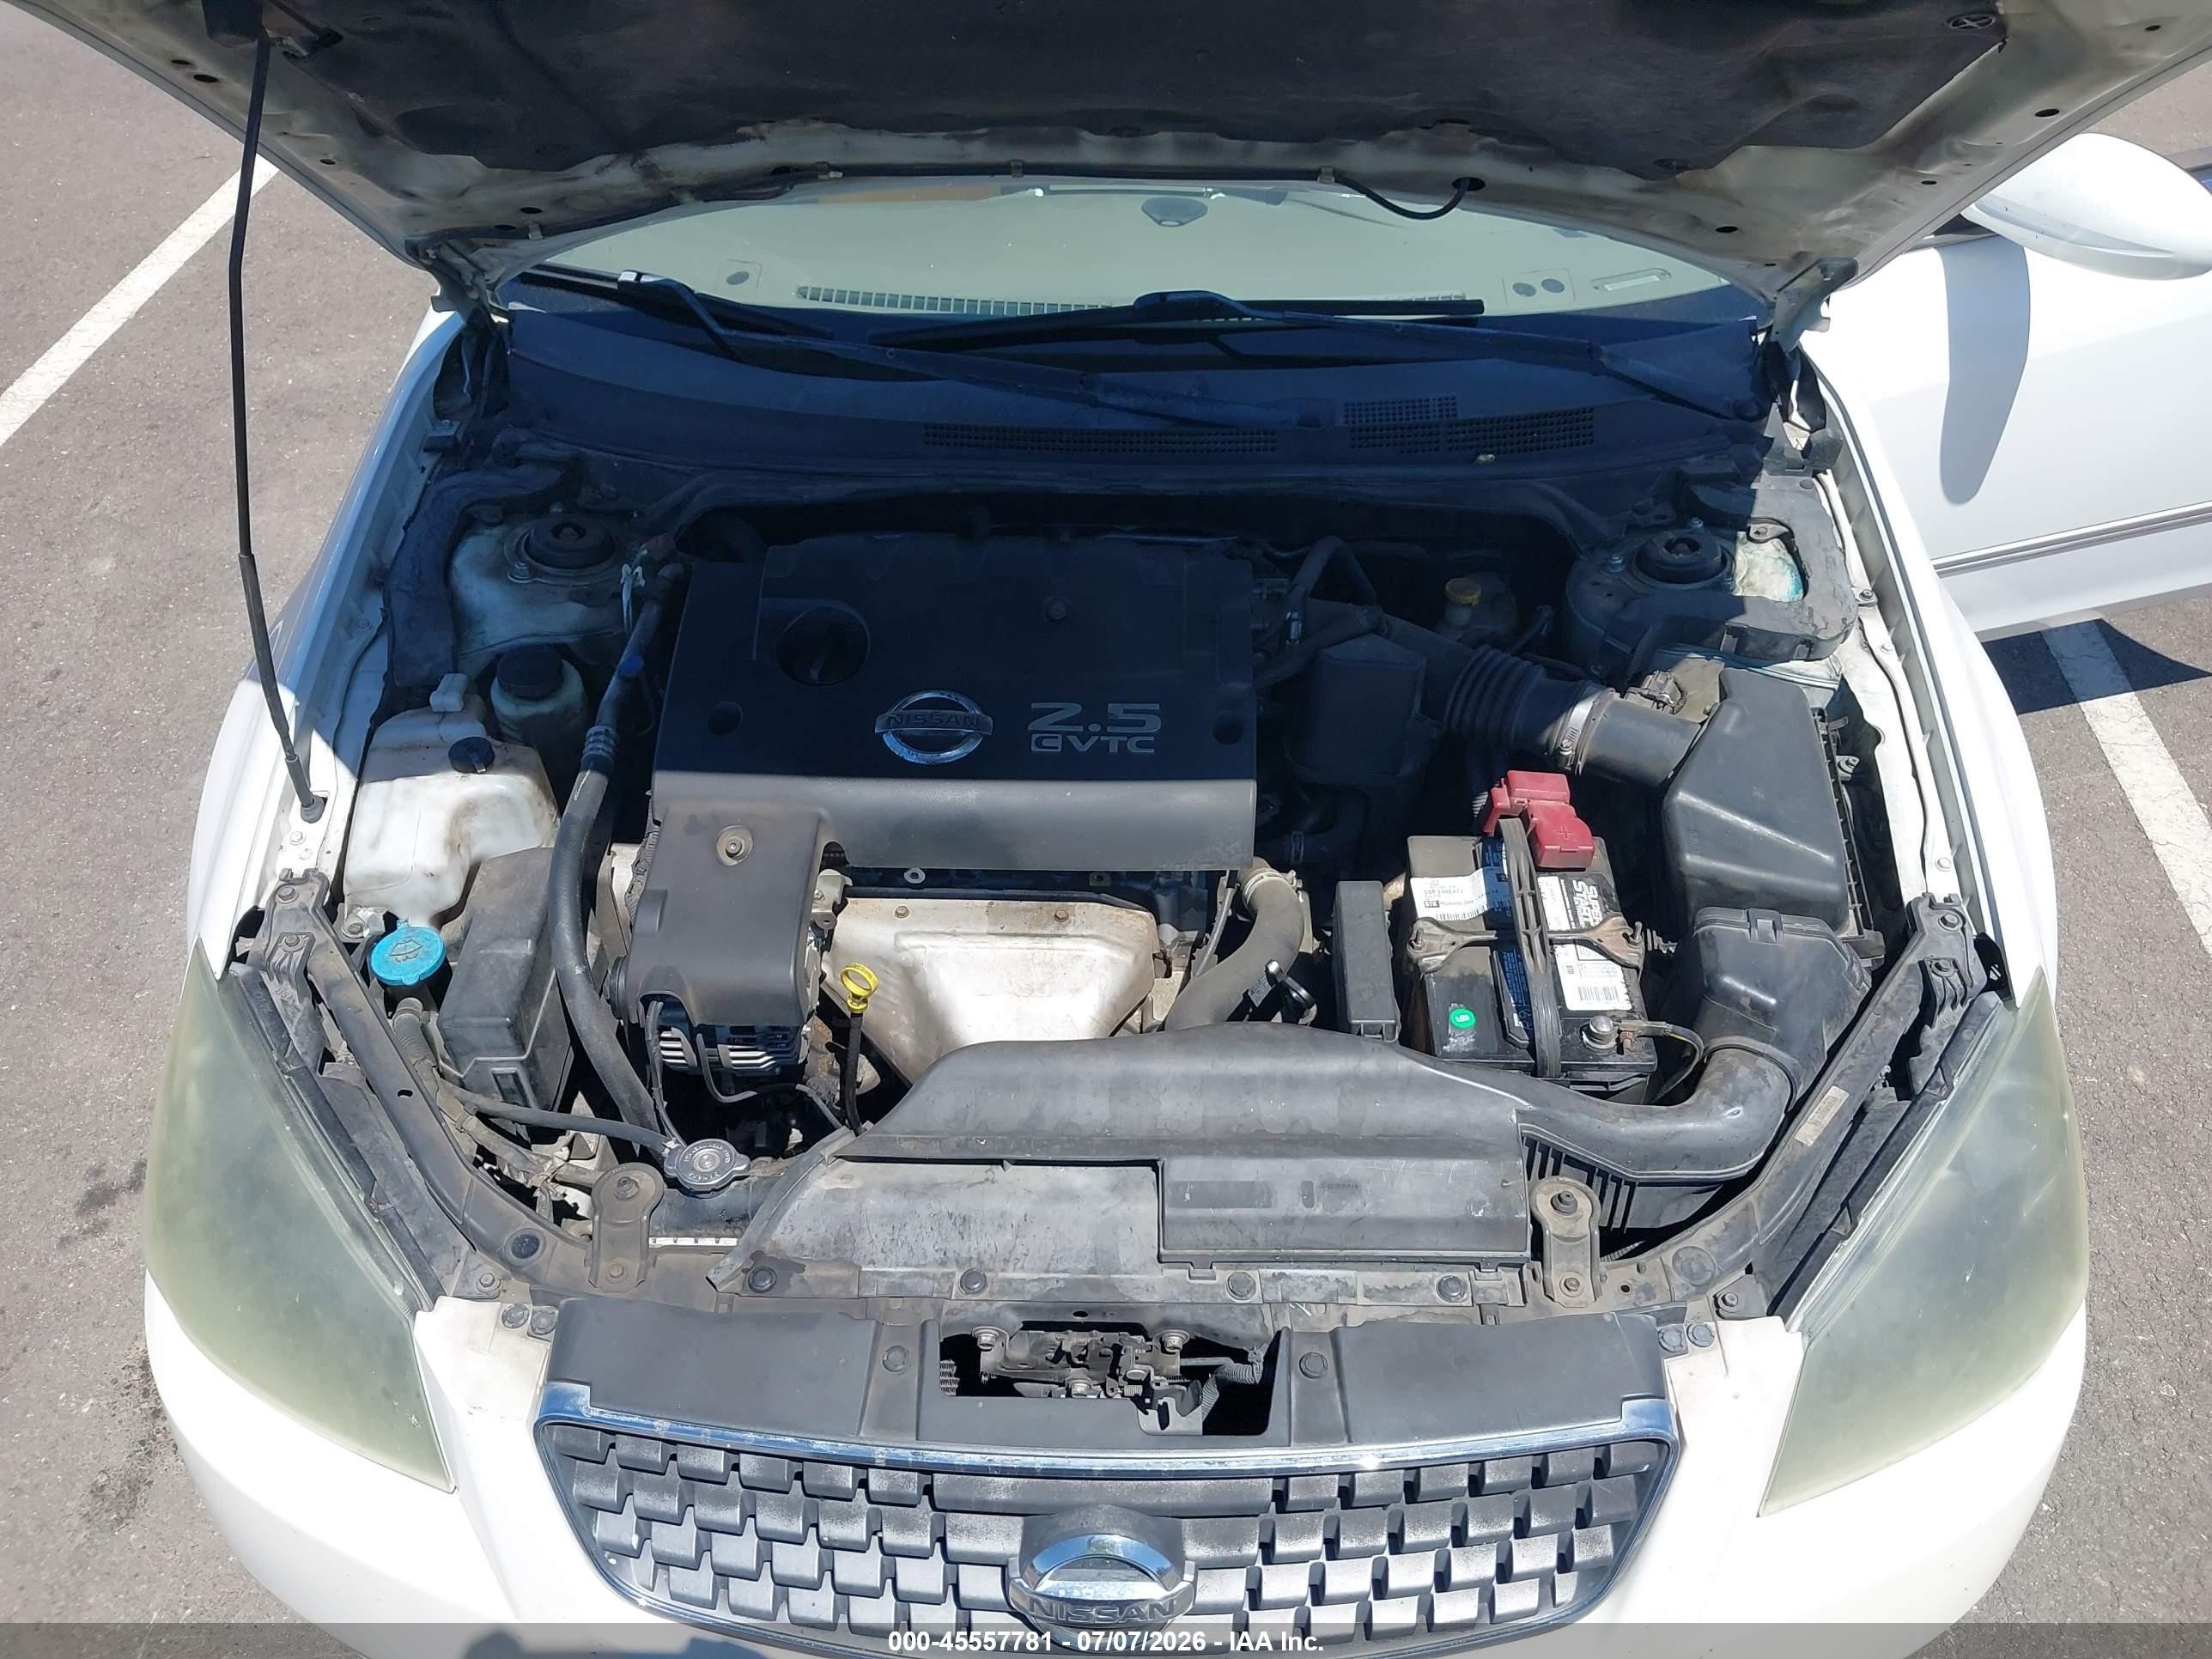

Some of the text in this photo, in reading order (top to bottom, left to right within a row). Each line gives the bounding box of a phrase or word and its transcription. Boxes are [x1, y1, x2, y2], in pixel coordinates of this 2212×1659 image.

[886, 712, 979, 728] NISSAN
[1027, 702, 1162, 733] 2.5
[1572, 879, 1595, 927] START
[1585, 885, 1602, 927] SUPER
[1030, 1599, 1176, 1623] NISSAN
